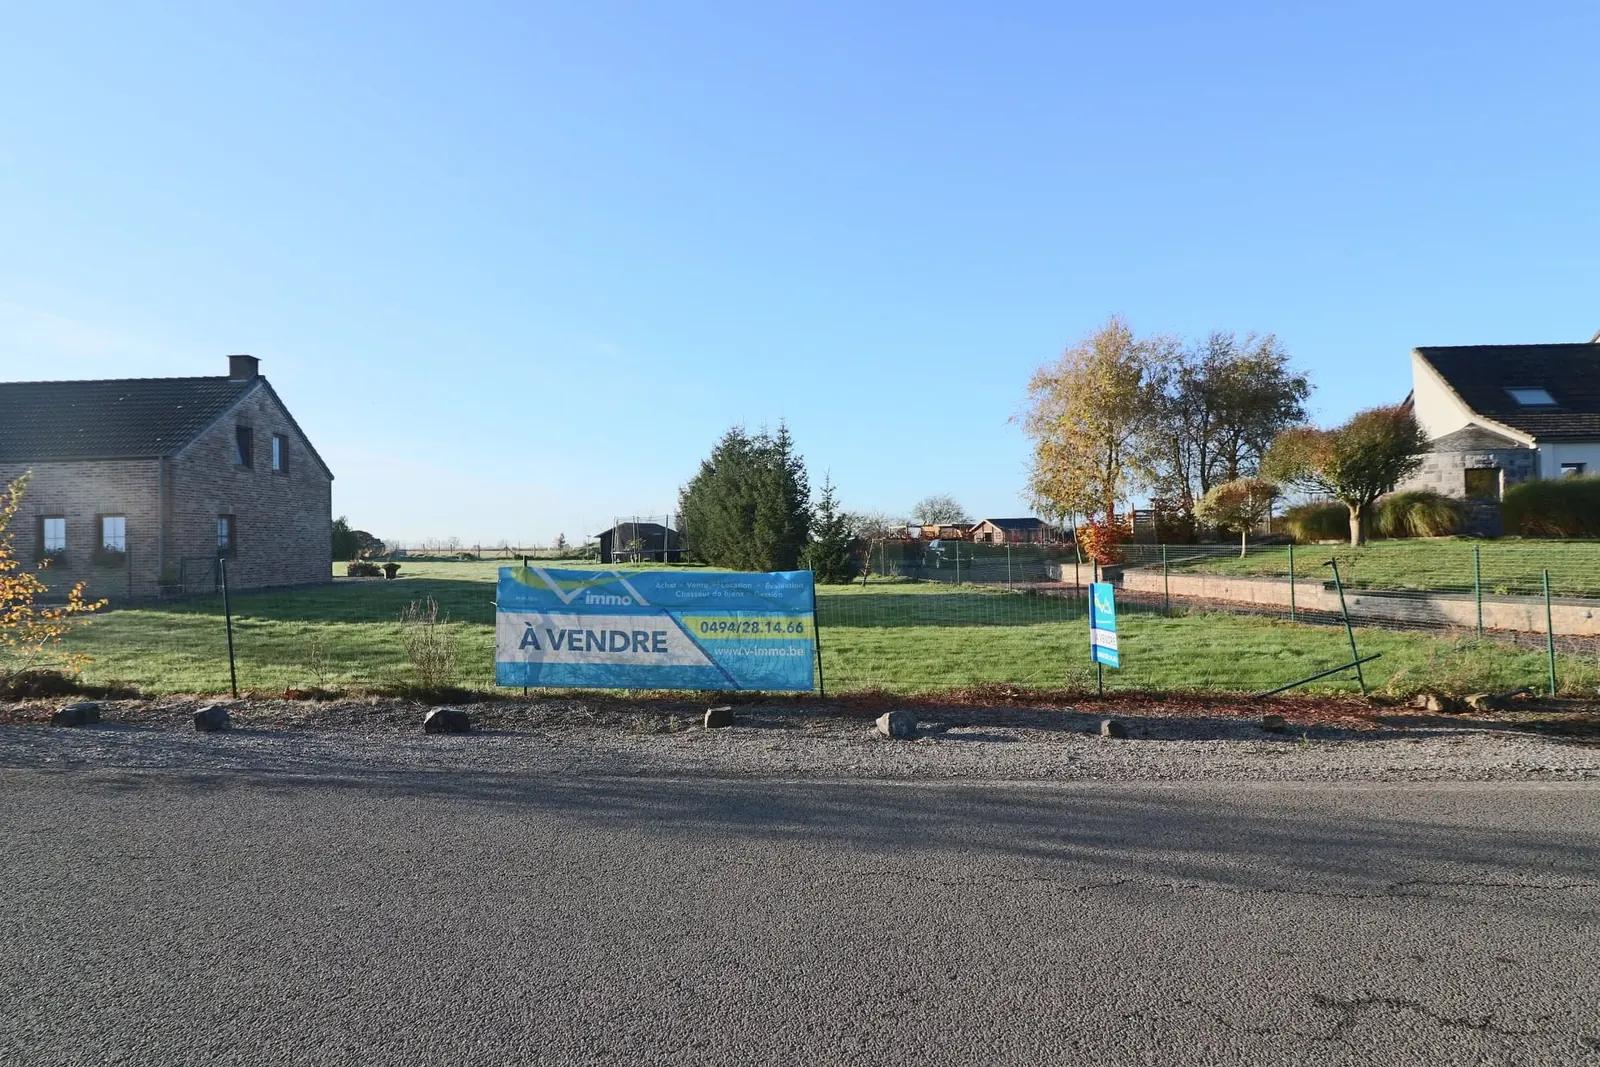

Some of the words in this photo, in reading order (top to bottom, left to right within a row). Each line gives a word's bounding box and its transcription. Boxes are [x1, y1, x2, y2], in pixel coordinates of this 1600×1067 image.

[585, 590, 632, 605] immo
[700, 621, 804, 635] 0494/28.14.66
[518, 621, 542, 651] À
[545, 628, 668, 654] VENDRE
[714, 645, 804, 658] www.v-immo.be
